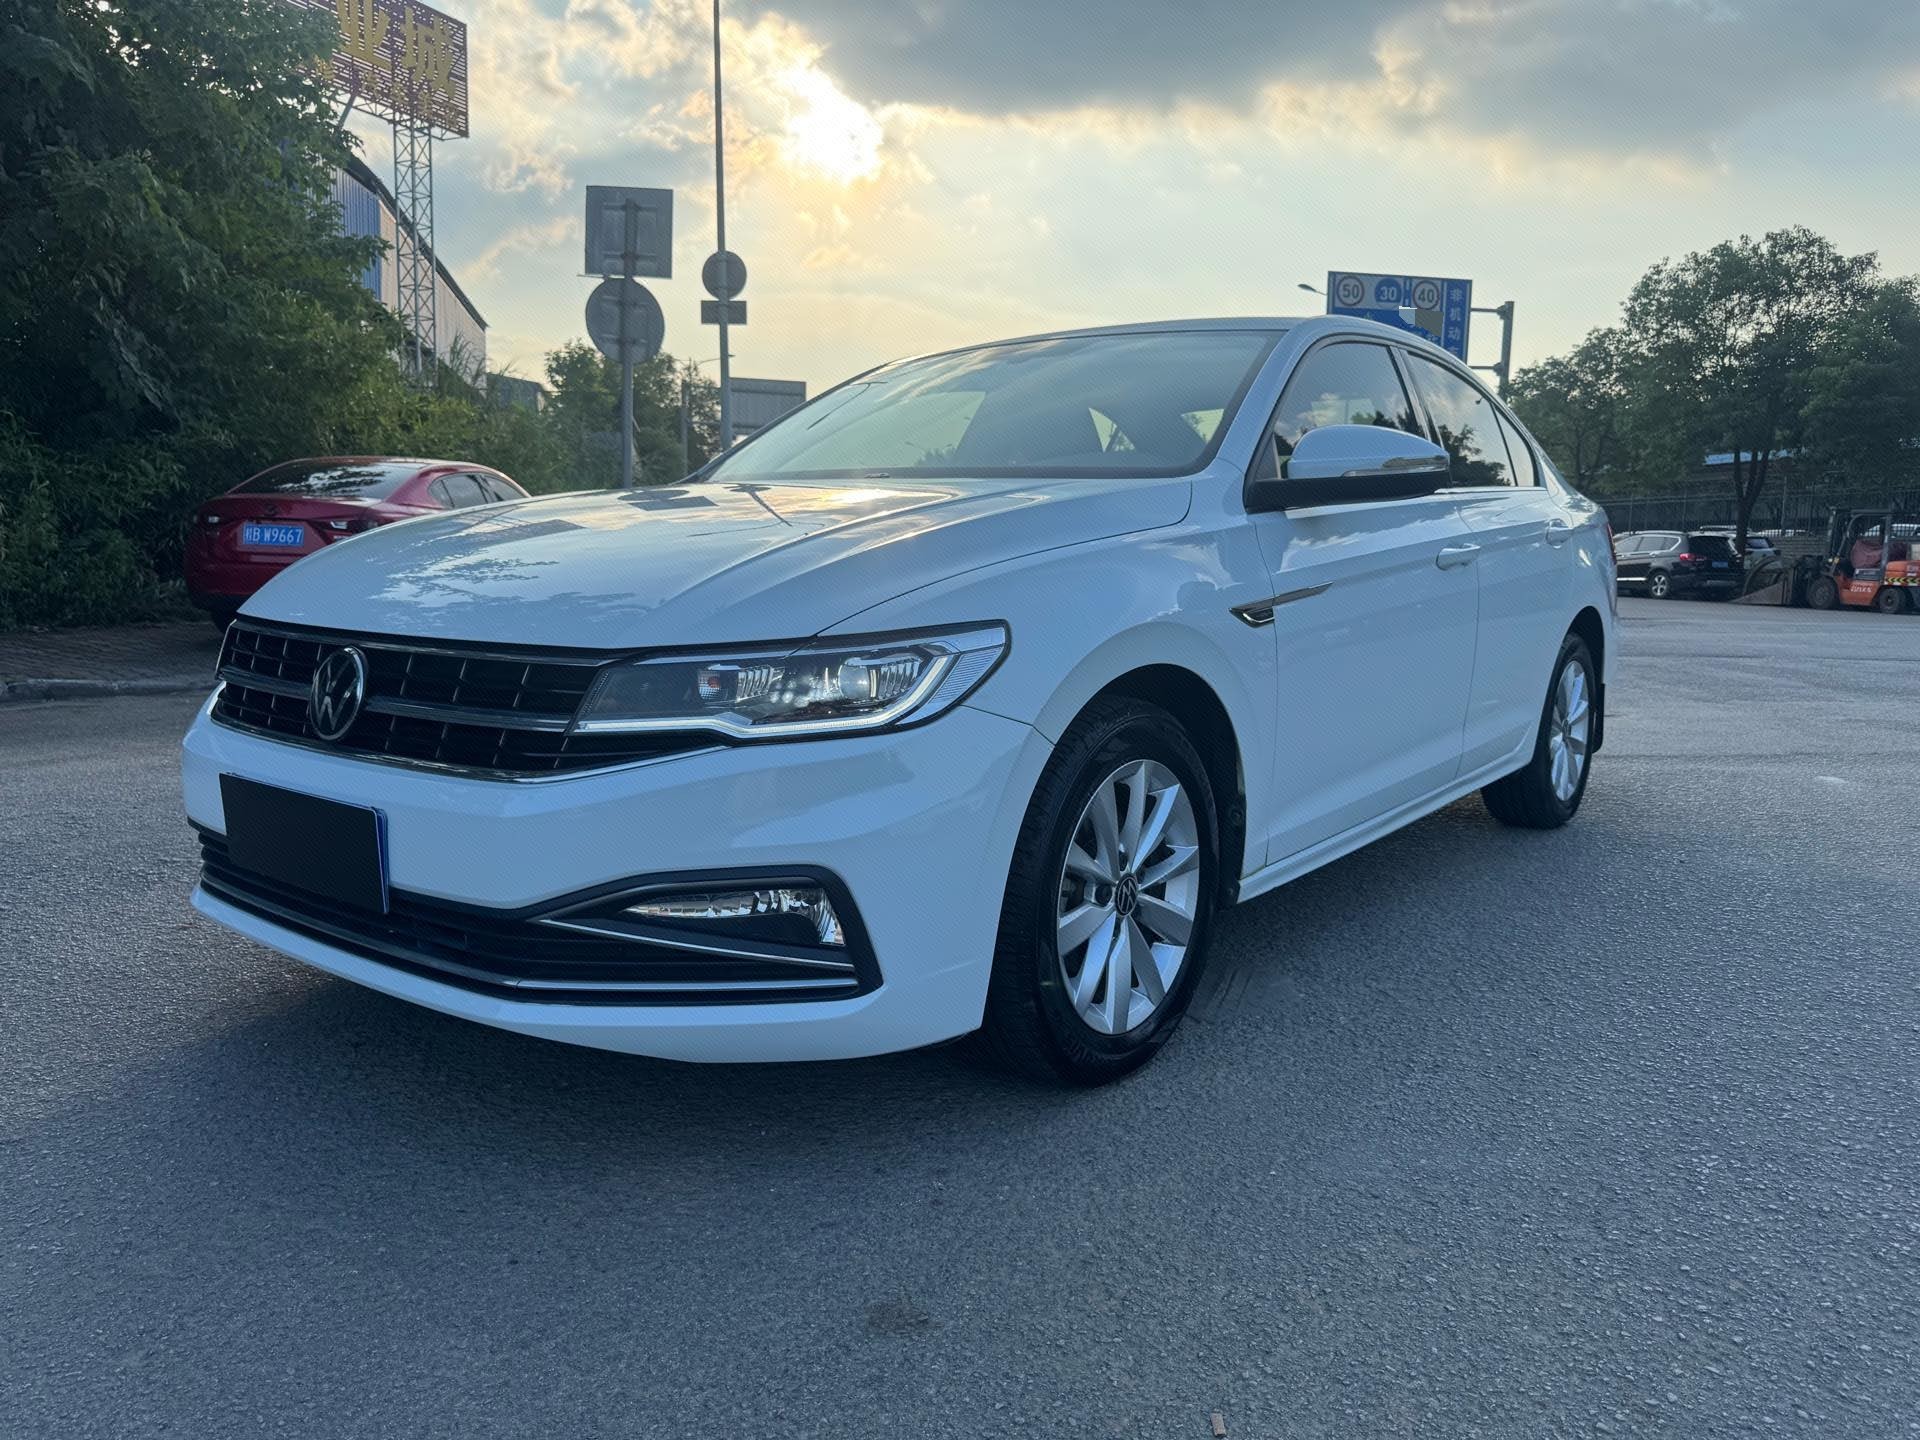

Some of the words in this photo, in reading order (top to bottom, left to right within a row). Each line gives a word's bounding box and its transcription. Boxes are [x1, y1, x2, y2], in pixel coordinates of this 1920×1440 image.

[1341, 284, 1360, 300] 50
[1380, 286, 1396, 301] 30
[1417, 286, 1434, 303] 40
[264, 528, 303, 543] W9667
